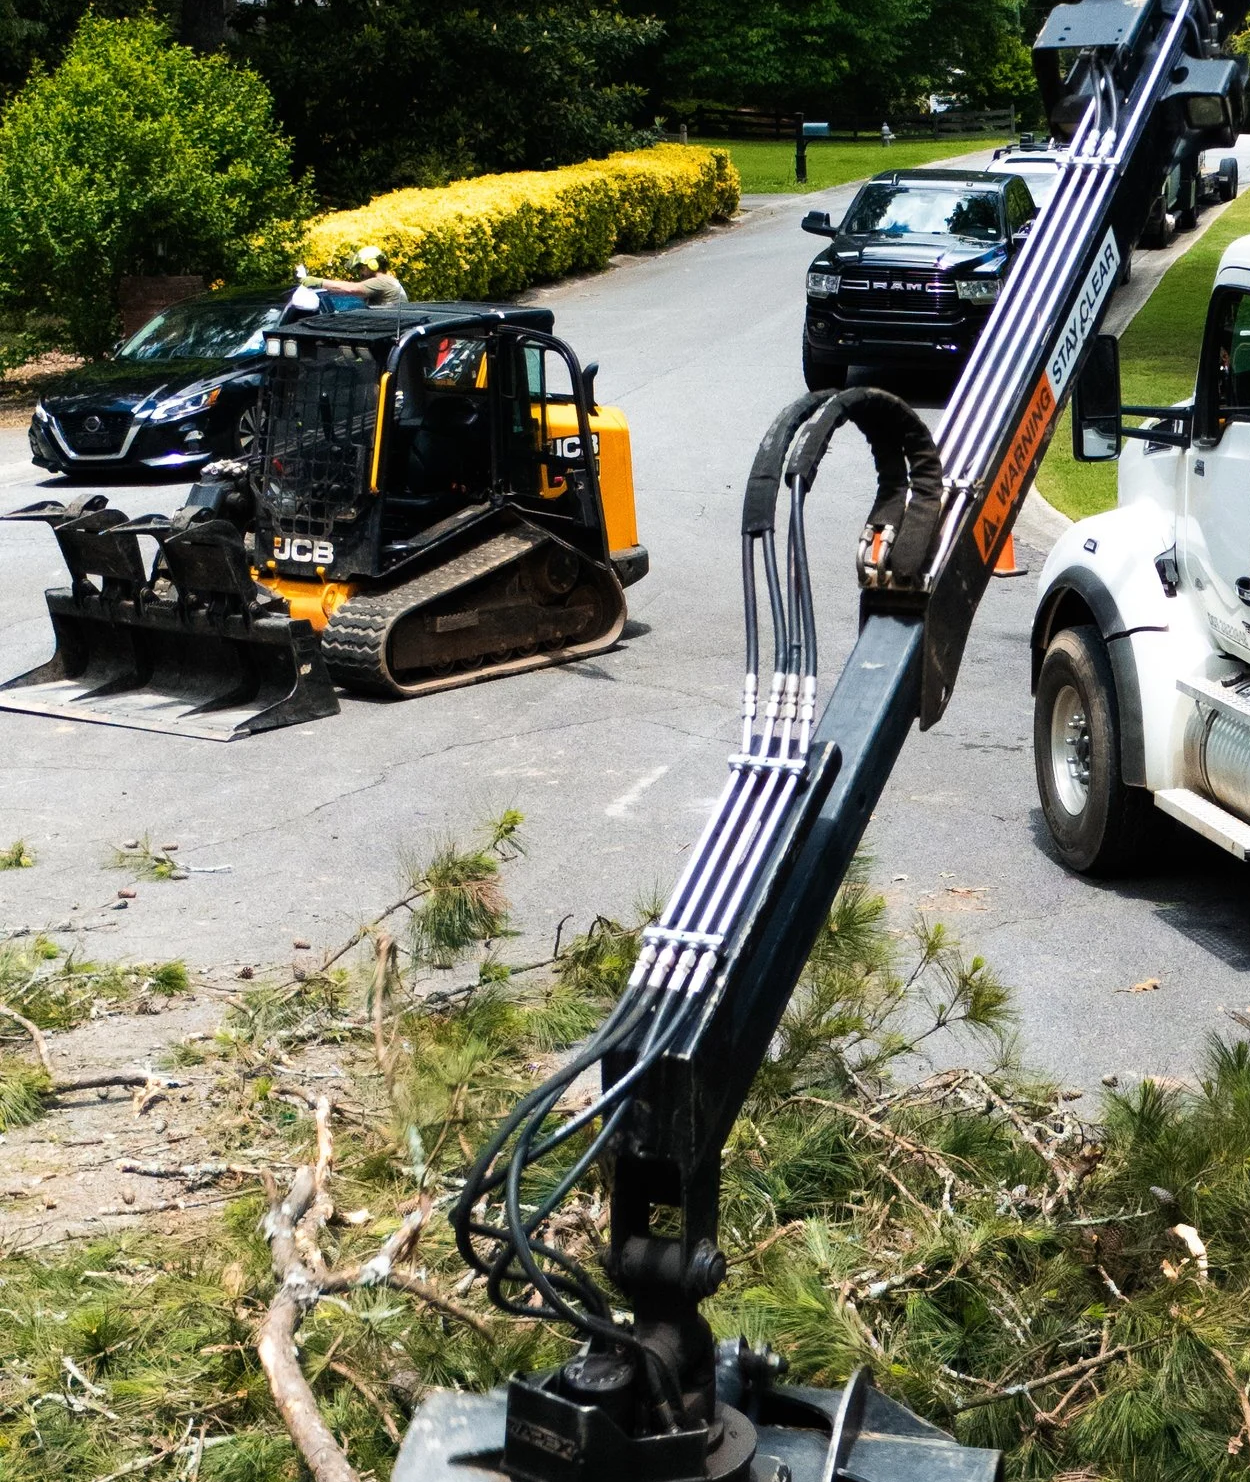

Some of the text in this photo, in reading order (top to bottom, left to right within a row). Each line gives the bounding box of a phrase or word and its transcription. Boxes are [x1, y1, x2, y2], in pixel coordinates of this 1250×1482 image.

[872, 281, 922, 291] RAM
[996, 243, 1115, 506] WARNING STAY CLEAR
[273, 536, 334, 564] JCB
